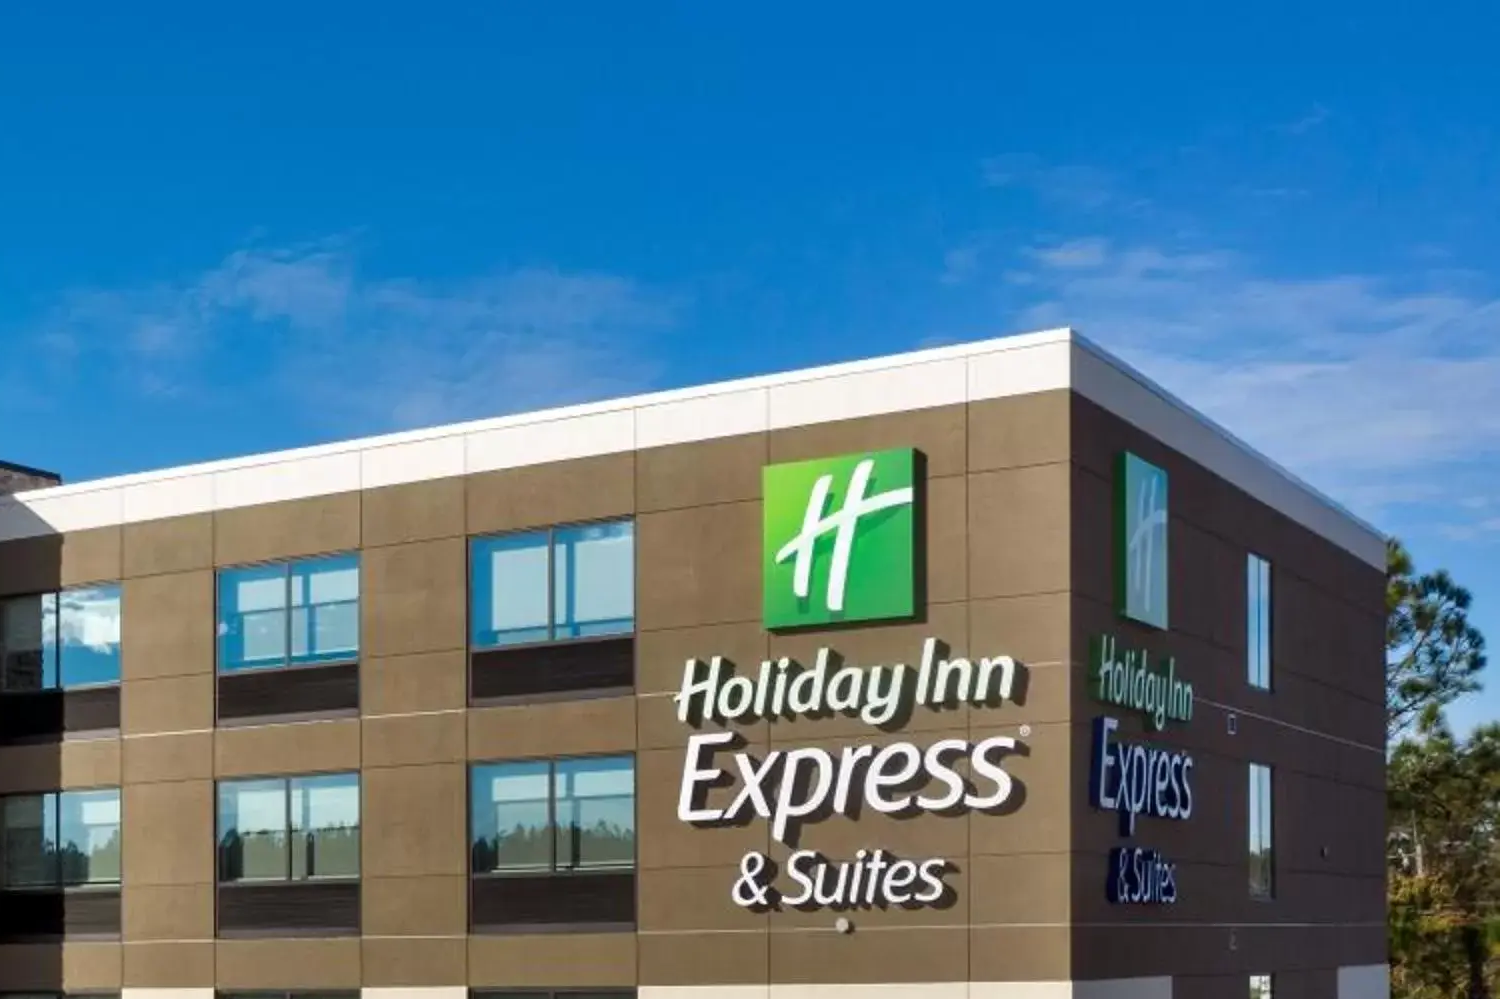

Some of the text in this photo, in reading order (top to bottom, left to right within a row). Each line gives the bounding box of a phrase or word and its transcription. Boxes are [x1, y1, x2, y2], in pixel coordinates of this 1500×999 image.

[775, 458, 913, 612] H
[673, 636, 1015, 725] Holiday Inn
[1098, 633, 1193, 731] Holiday Inn
[677, 731, 1015, 842] Express
[1099, 716, 1193, 836] Express
[731, 849, 946, 906] & Suites
[1131, 848, 1176, 903] Suites
